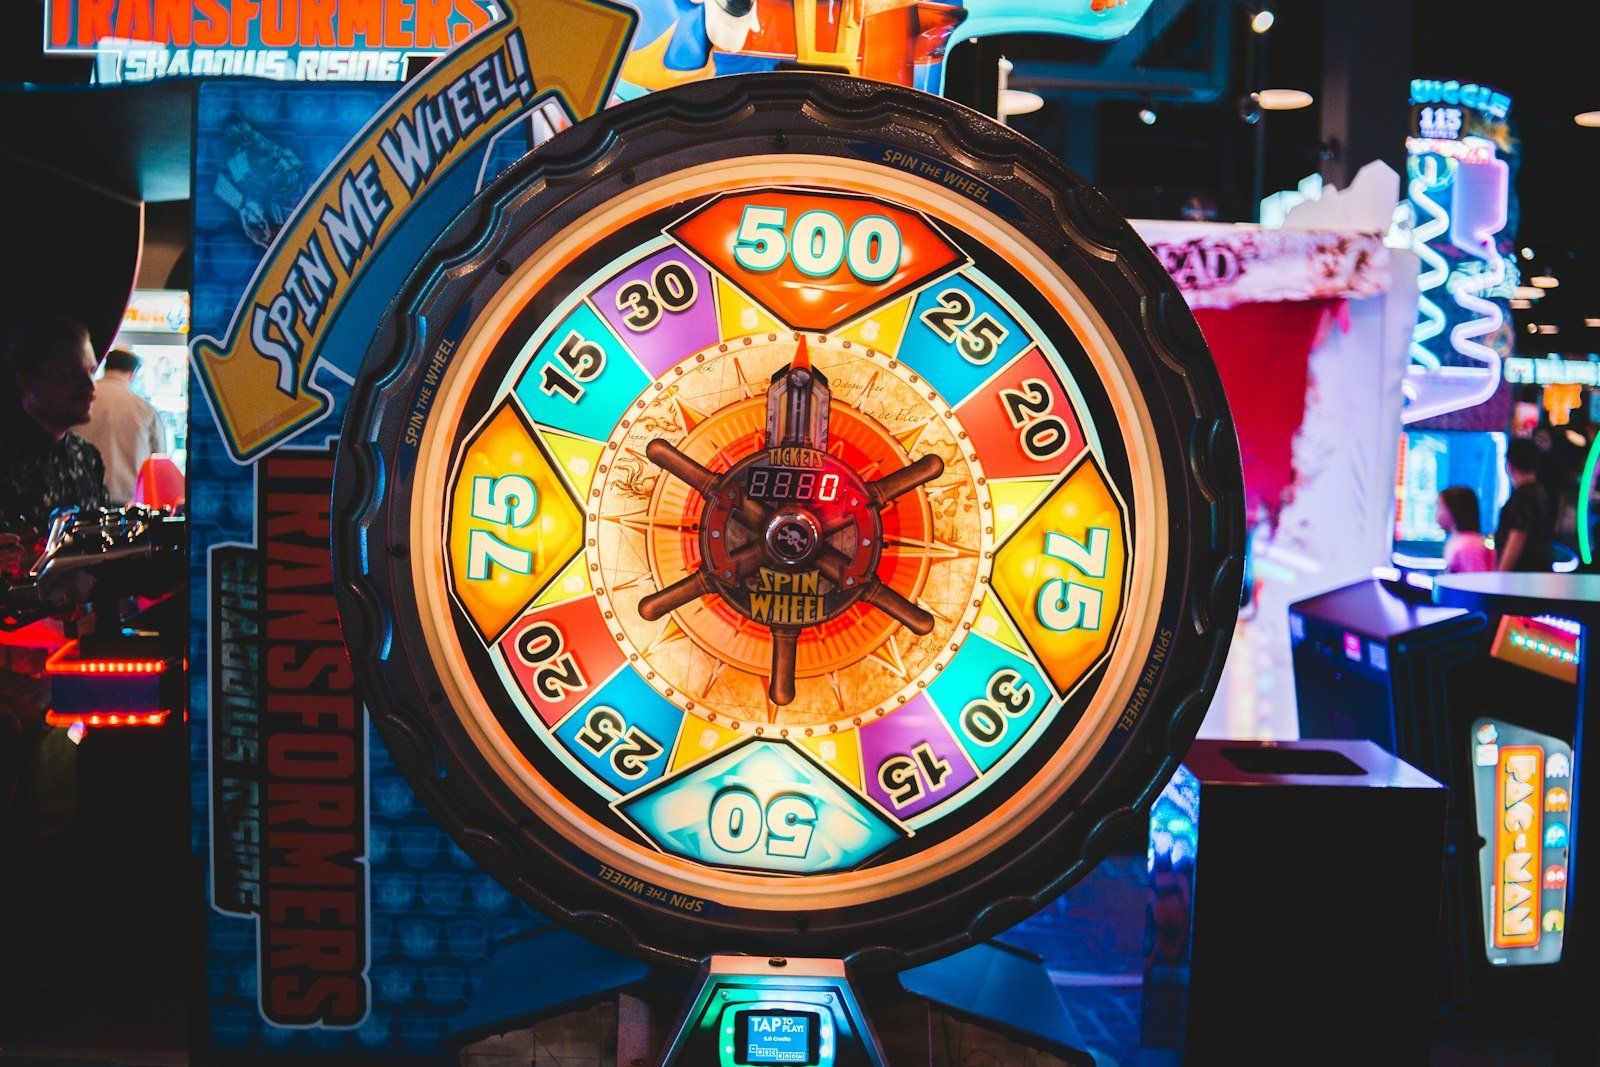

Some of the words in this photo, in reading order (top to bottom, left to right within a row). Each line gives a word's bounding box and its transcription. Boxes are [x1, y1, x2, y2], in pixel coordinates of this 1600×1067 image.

[296, 50, 403, 82] RISING
[883, 149, 918, 170] SPIN
[919, 161, 943, 179] THE
[943, 170, 990, 203] WHEEL
[251, 229, 338, 398] SPIN
[321, 155, 393, 275] ME
[379, 28, 536, 198] WHEEL!
[733, 204, 902, 282] 500
[616, 260, 698, 332] 30
[1151, 243, 1243, 290] EAD
[920, 288, 1009, 365] 25
[405, 411, 425, 447] SPIN
[417, 386, 432, 410] THE
[425, 339, 455, 386] WHEEL
[539, 329, 607, 405] 15
[998, 378, 1070, 461] 20
[768, 448, 824, 468] TICKETS
[467, 474, 537, 581] 75
[750, 593, 829, 625] WHEEL
[759, 567, 820, 595] SPIN
[1038, 527, 1110, 631] 75
[514, 621, 588, 703] 20
[1143, 664, 1159, 687] THE
[1152, 627, 1172, 662] SPIN
[959, 669, 1035, 747] 30
[1118, 687, 1149, 732] WHEEL
[574, 705, 664, 780] 25
[877, 742, 952, 810] 15
[709, 789, 818, 859] 50
[1503, 755, 1536, 937] PAC-MAN
[597, 864, 644, 894] WHEEL
[646, 886, 667, 902] THE
[669, 894, 704, 912] SPIN
[751, 1017, 782, 1032] TAP
[782, 1017, 793, 1025] TO
[782, 1025, 804, 1033] PLAY!
